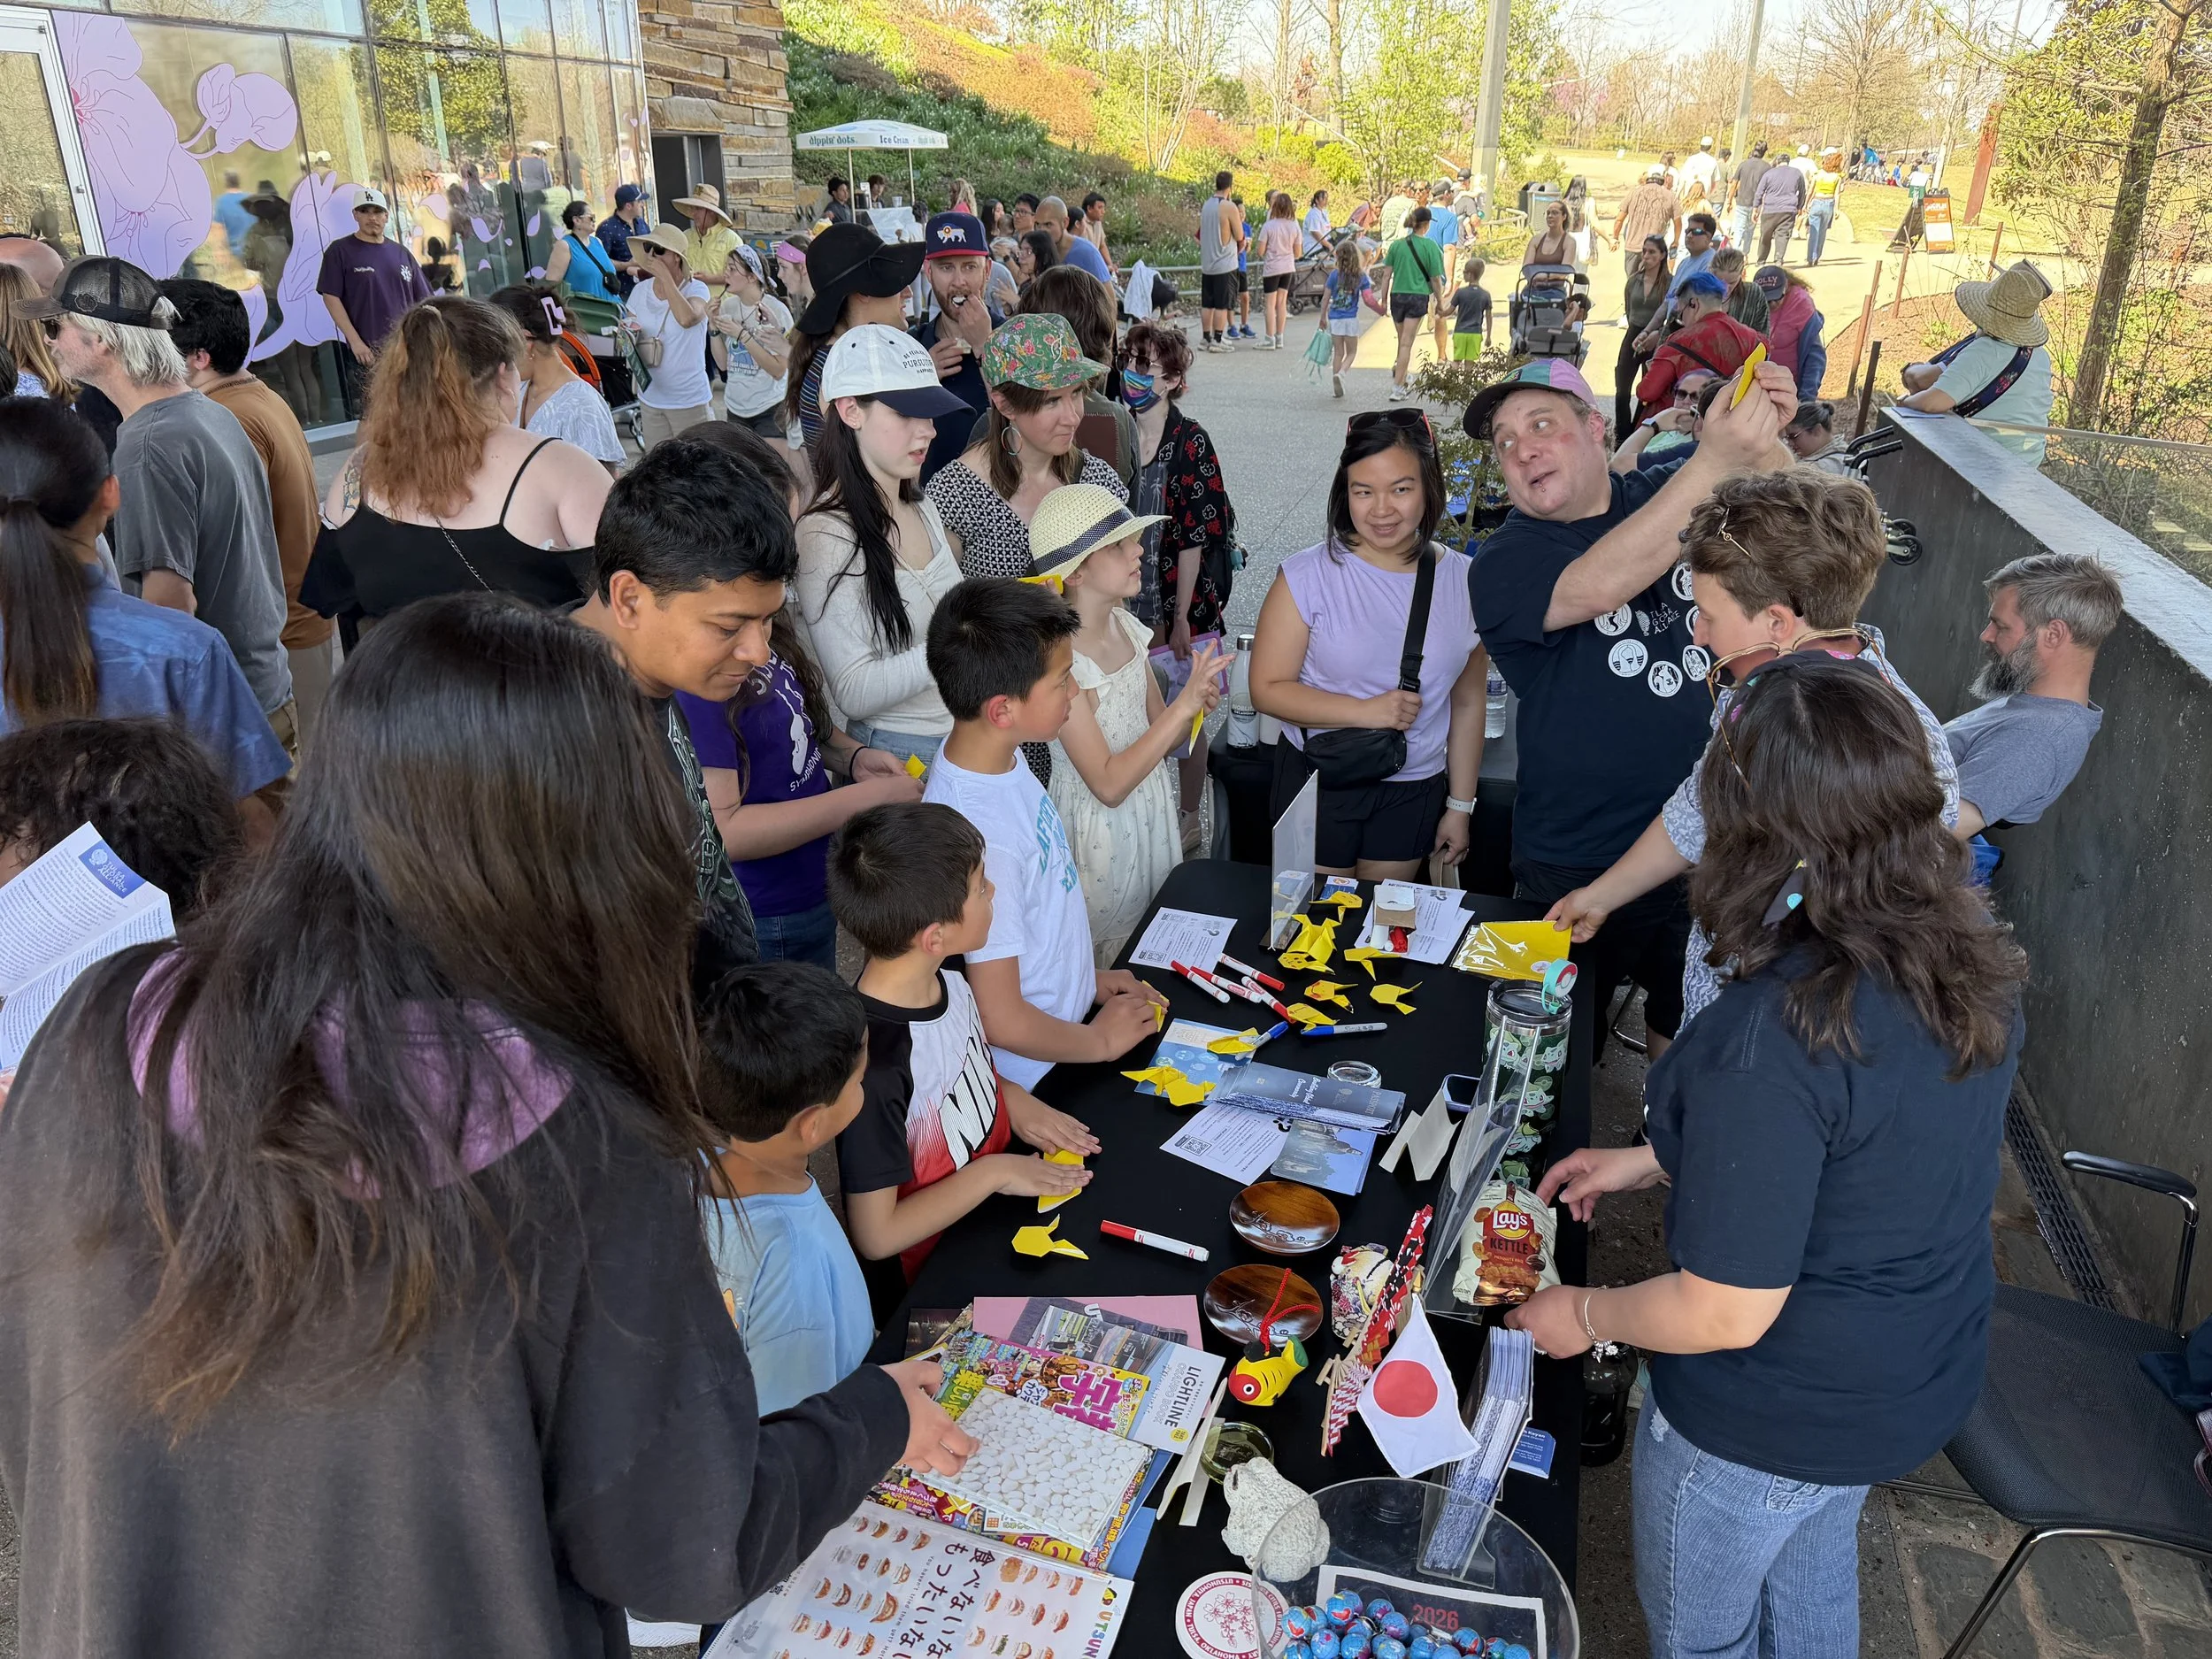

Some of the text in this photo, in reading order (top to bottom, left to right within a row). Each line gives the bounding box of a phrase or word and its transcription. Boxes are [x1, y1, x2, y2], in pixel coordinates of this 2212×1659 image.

[879, 134, 893, 143] Ice
[365, 191, 373, 202] LA
[97, 868, 128, 893] ALLIANCE
[108, 861, 126, 879] TULSA
[1493, 1210, 1528, 1231] Lay's
[1490, 1237, 1529, 1256] KETTLE
[1164, 1366, 1202, 1428] LIGHTLINE
[913, 1568, 928, 1591] haven't
[903, 1593, 916, 1609] tried
[895, 1610, 907, 1626] them
[1412, 1603, 1459, 1632] 2026
[1082, 1610, 1113, 1659] UTSUN
[1187, 1623, 1240, 1659] TULSA, OKLAHOMA
